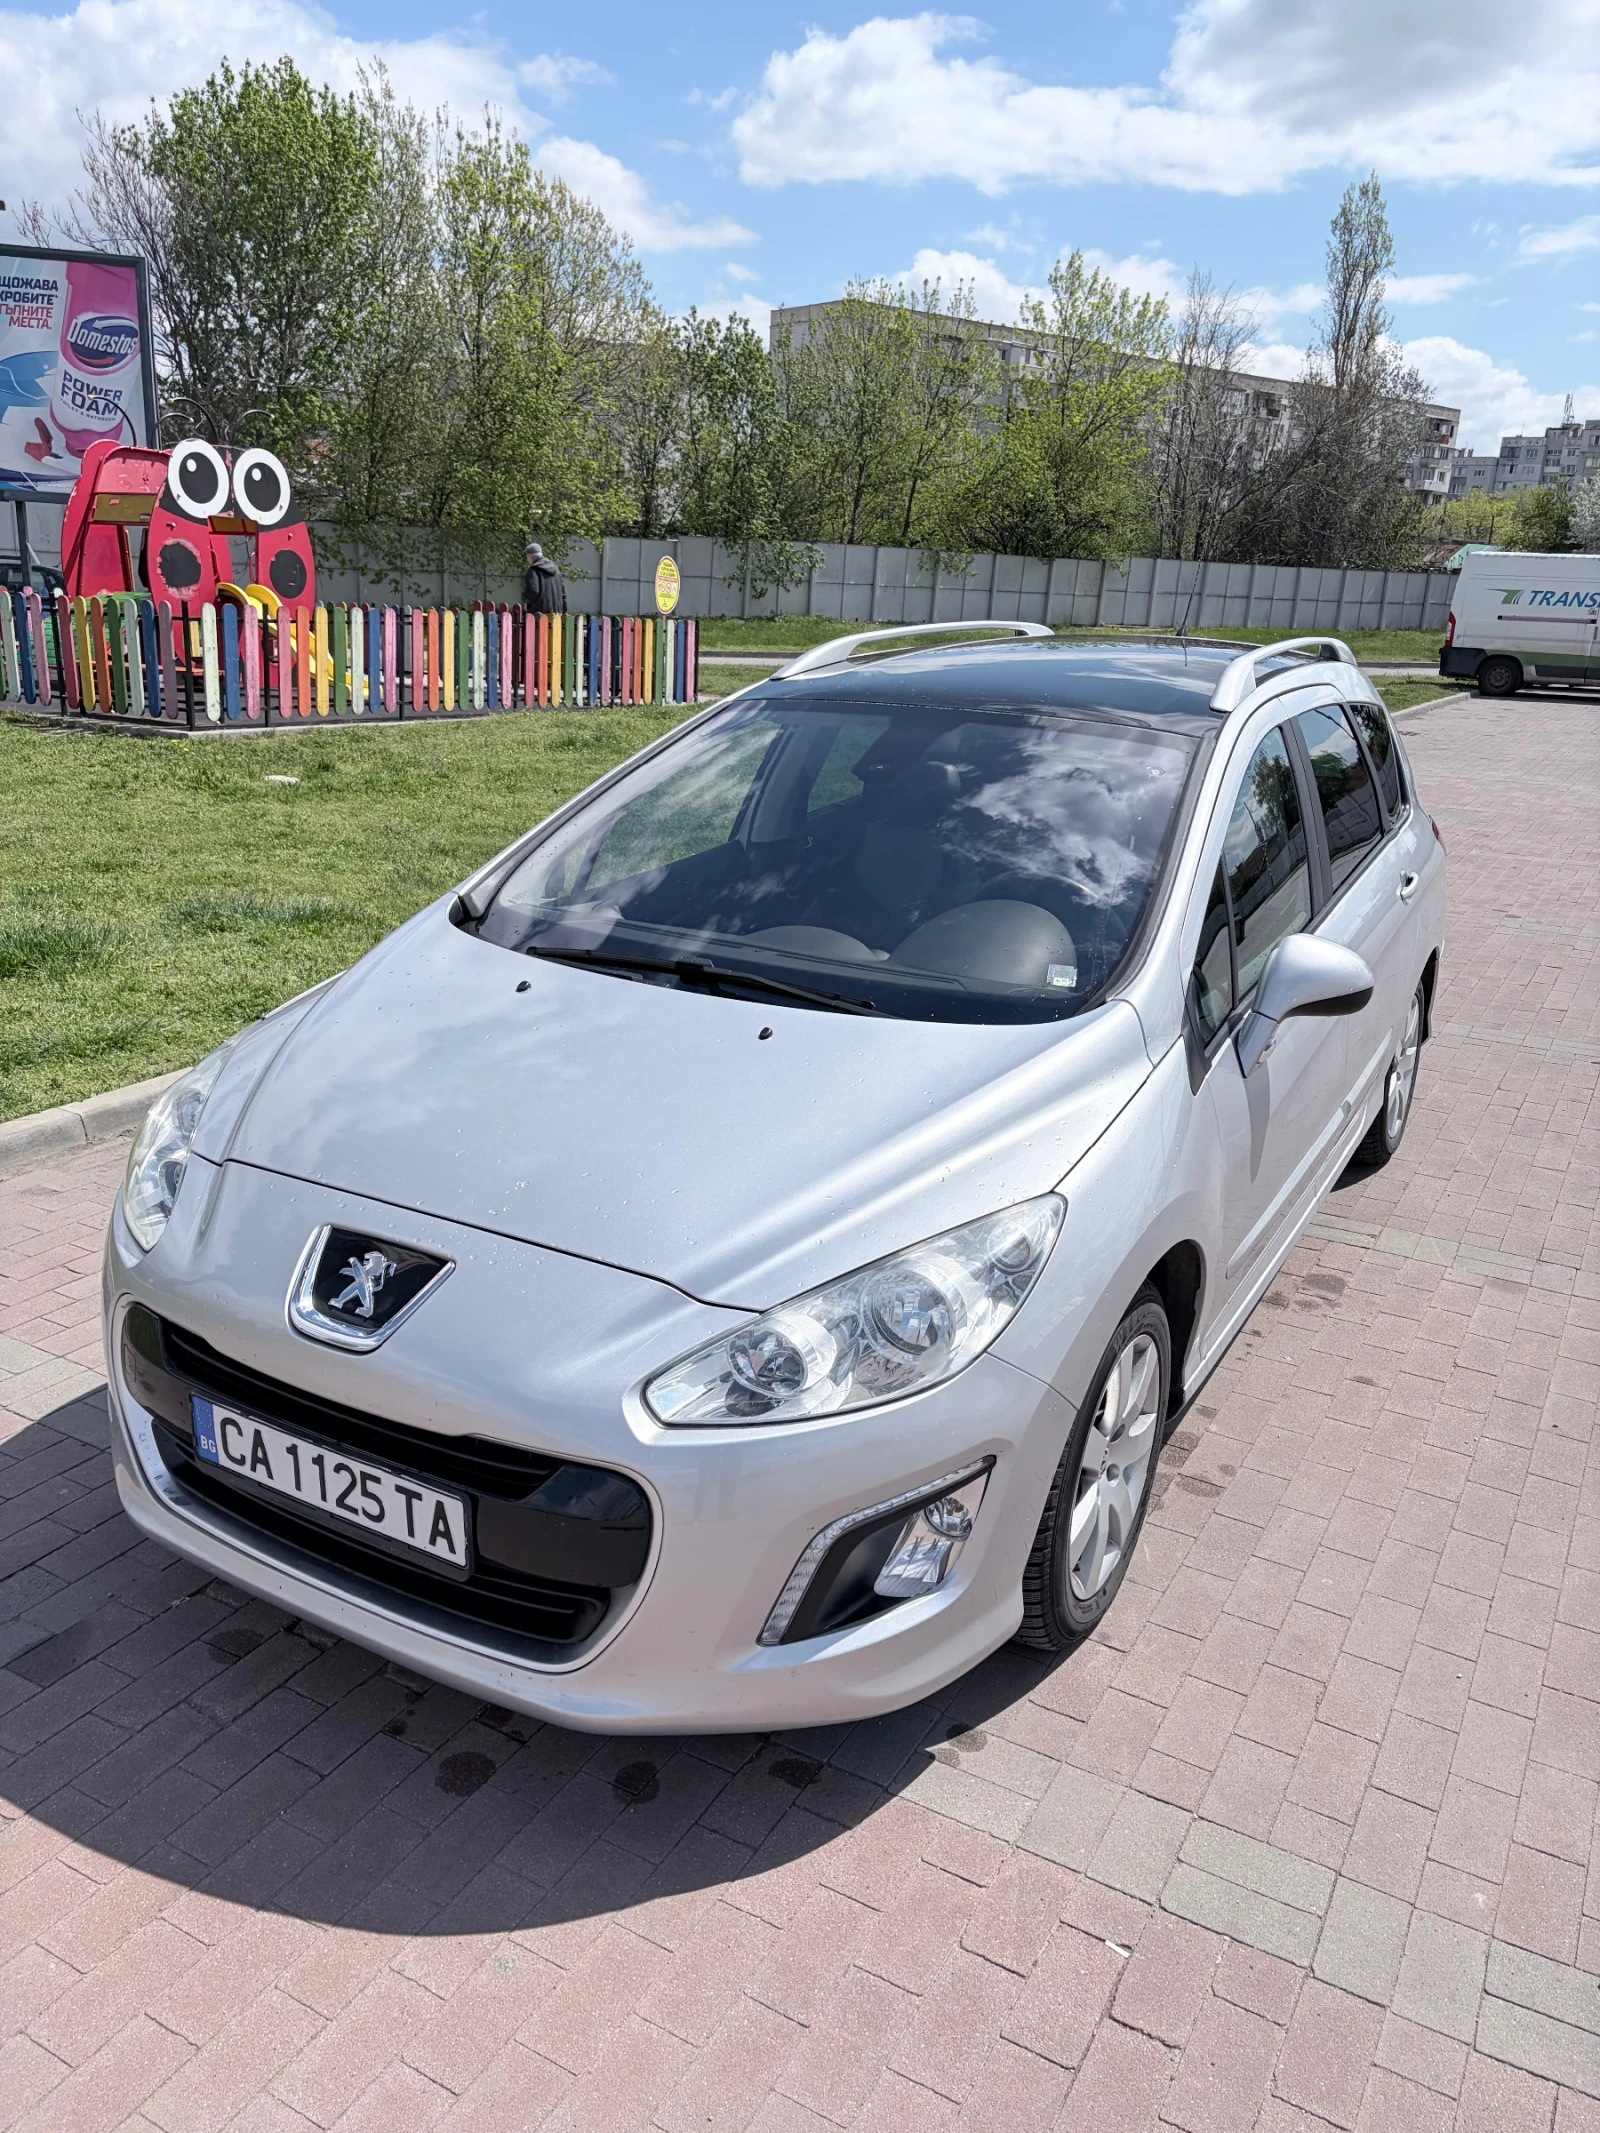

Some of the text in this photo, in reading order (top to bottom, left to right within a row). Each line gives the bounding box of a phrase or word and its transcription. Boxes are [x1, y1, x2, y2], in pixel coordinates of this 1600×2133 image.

[8, 315, 52, 330] МЕСТА.
[67, 317, 139, 355] Domestos
[61, 382, 119, 416] FOAM
[63, 370, 123, 402] POWER
[1528, 590, 1600, 608] TRANS
[201, 1435, 217, 1454] BG
[219, 1417, 457, 1555] CA 1125 TA
